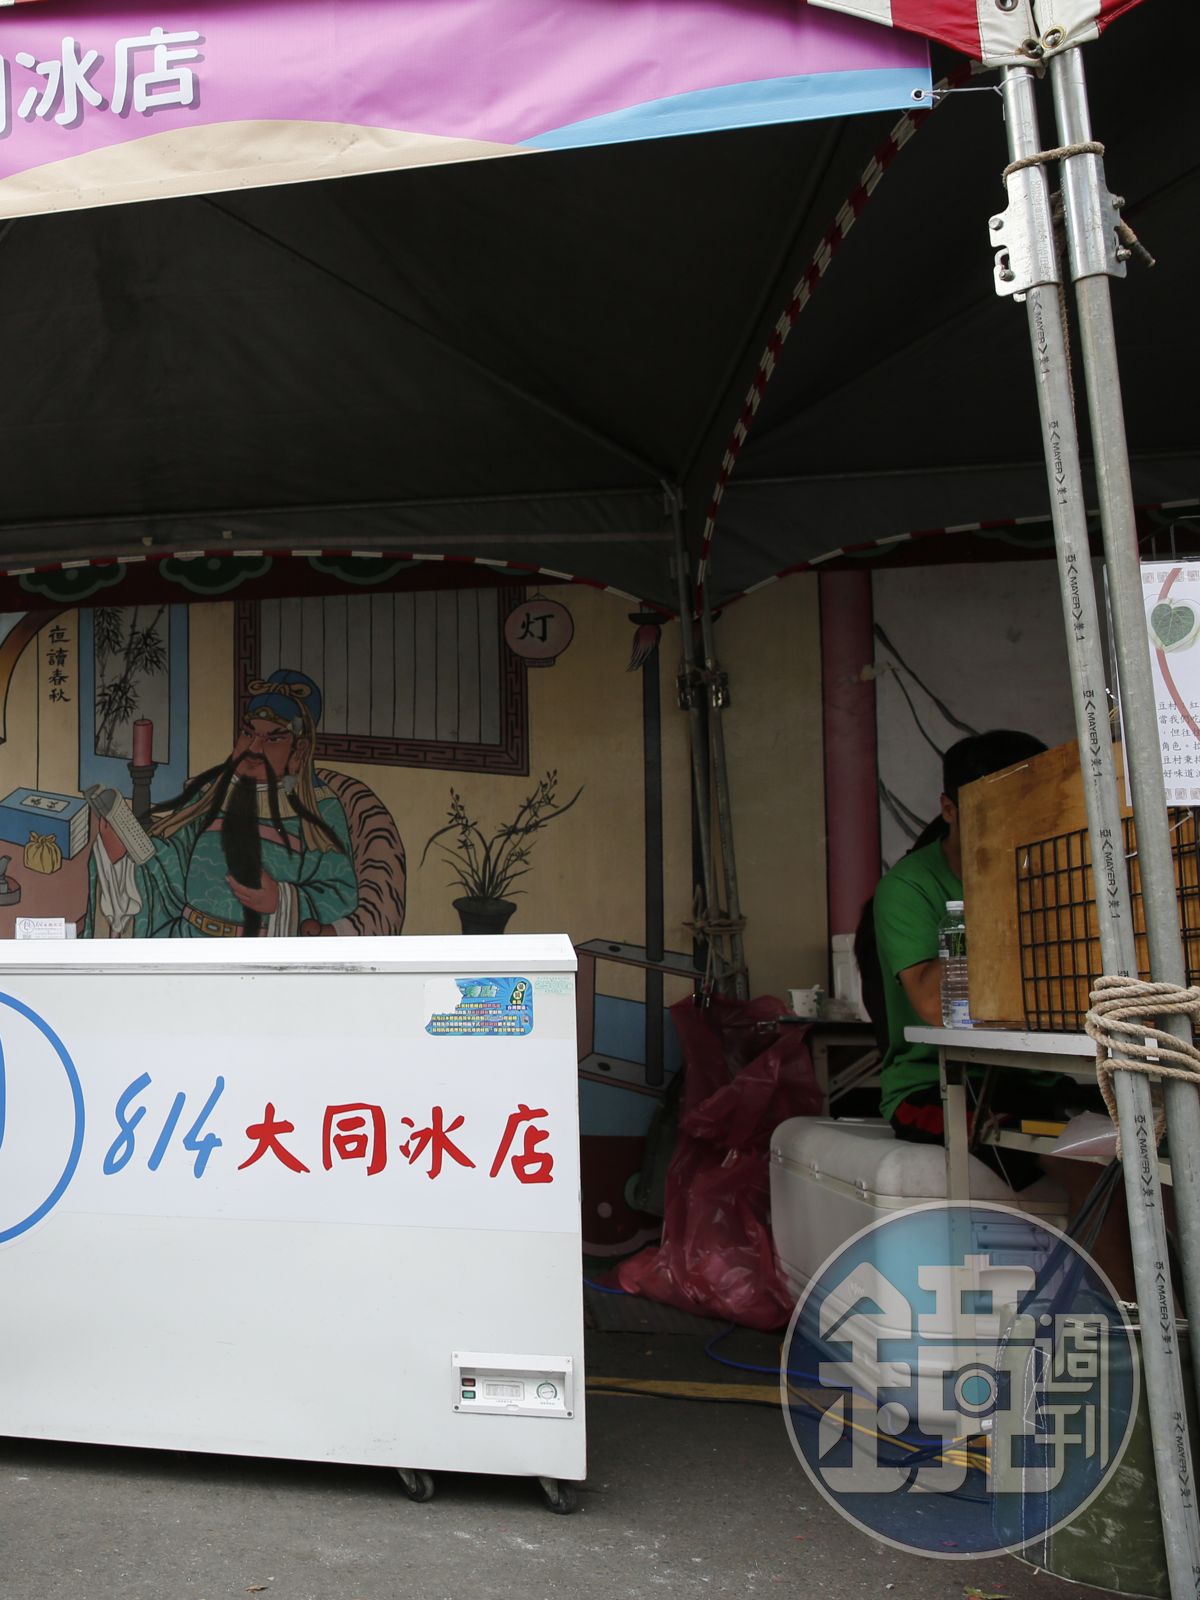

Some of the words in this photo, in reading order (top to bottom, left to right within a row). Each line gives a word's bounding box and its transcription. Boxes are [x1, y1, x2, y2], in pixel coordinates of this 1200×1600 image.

[517, 612, 555, 642] 灯
[102, 1071, 226, 1180] 814
[237, 1102, 555, 1185] 大同冰店
